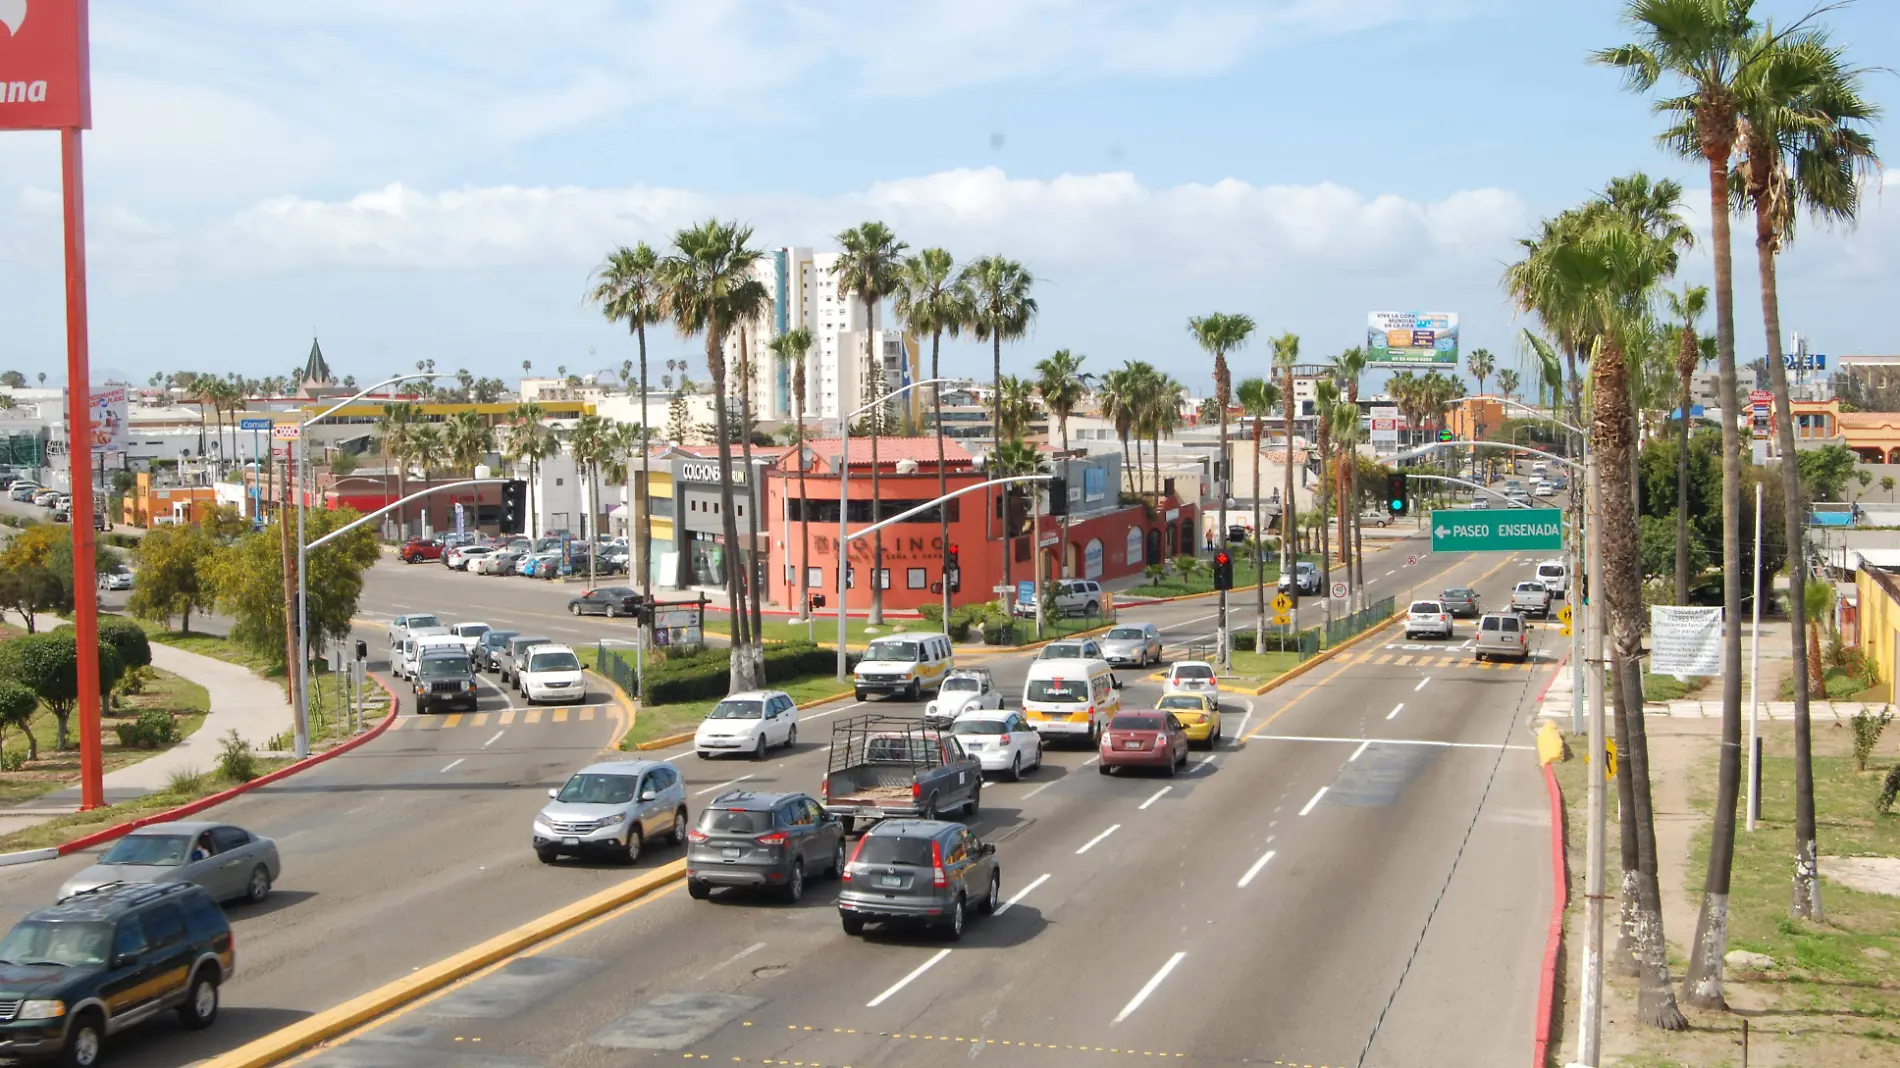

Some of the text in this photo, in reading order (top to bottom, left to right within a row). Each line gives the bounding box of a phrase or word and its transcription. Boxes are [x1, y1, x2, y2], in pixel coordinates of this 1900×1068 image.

[274, 426, 299, 437] OXXO
[683, 463, 720, 481] COLCHONE
[1453, 523, 1560, 538] PASEO ENSENADA
